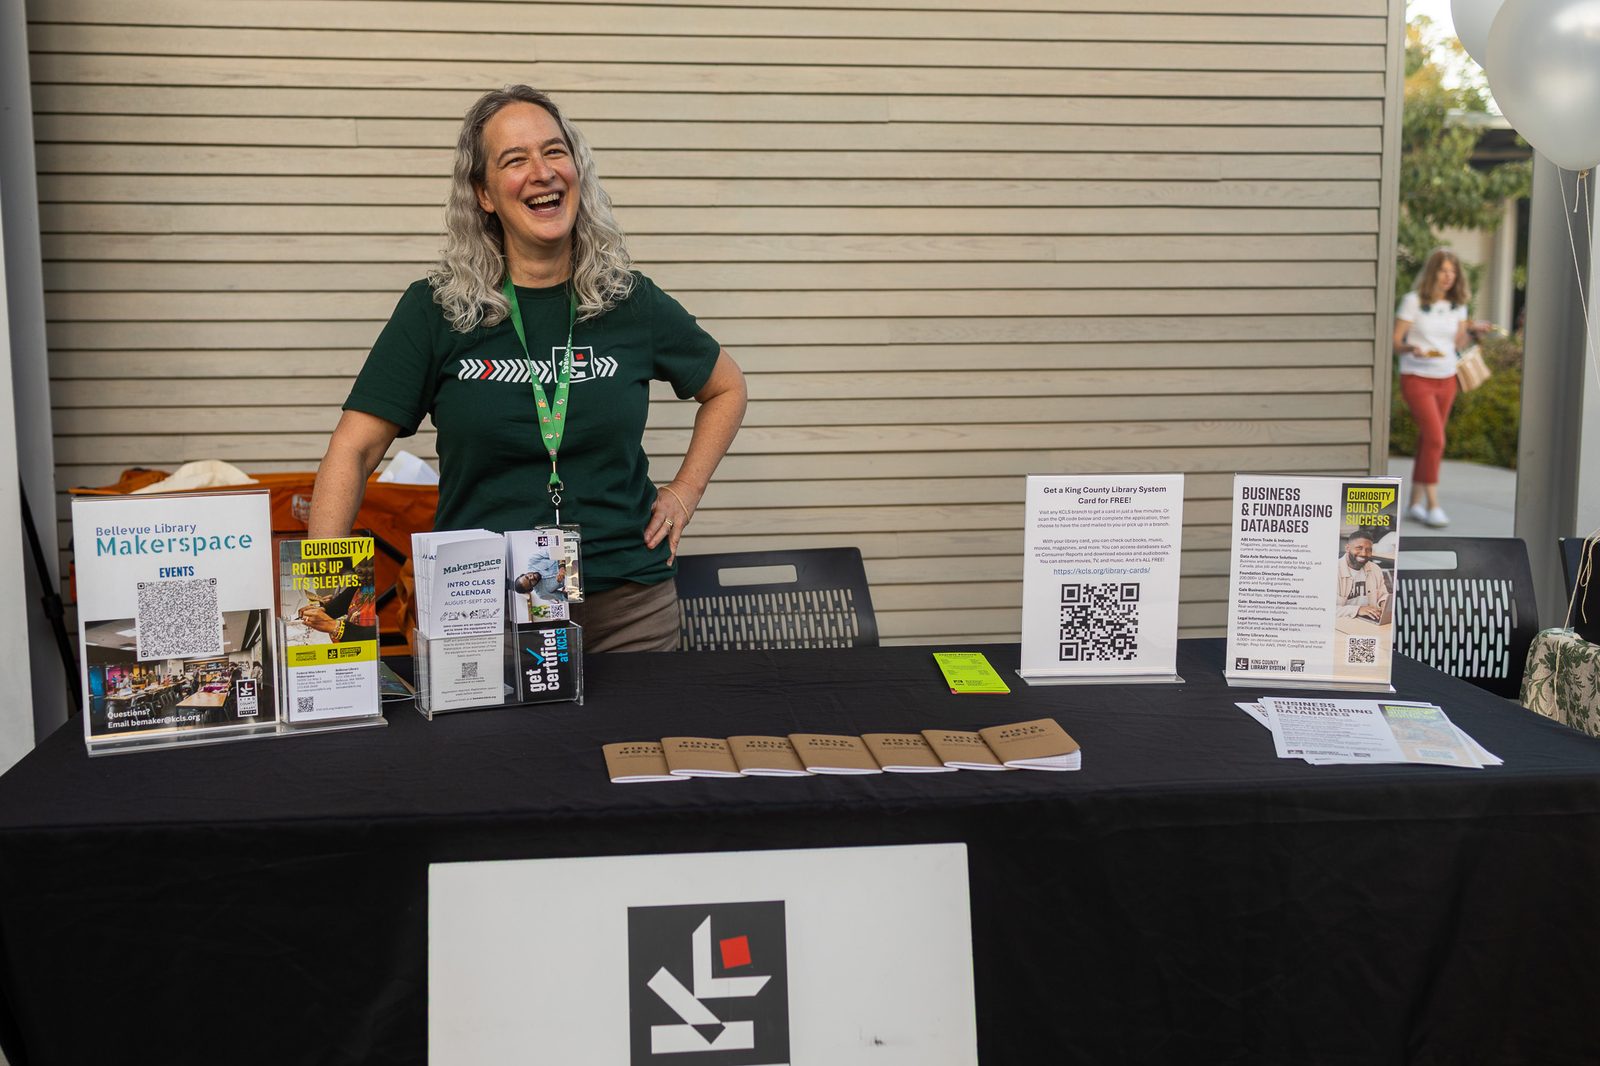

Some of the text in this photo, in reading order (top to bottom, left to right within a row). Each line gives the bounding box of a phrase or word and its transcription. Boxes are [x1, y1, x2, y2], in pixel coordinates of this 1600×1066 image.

[1065, 487, 1081, 495] King
[1083, 487, 1110, 495] County
[1111, 486, 1137, 494] Library
[1139, 486, 1166, 494] System
[1242, 486, 1300, 500] BUSINESS
[1349, 491, 1391, 500] CURIOSITY
[1241, 503, 1333, 518] & FUNDRAISING
[1346, 503, 1379, 513] BUILDS
[1241, 518, 1309, 533] DATABASES
[1346, 514, 1390, 526] SUCCESS
[96, 523, 197, 536] Bellevue Library
[96, 532, 252, 556] Makerspace
[304, 540, 364, 556] CURIOSITY
[159, 566, 194, 578] EVENTS
[292, 560, 344, 575] ROLLS UP
[443, 558, 502, 575] Makerspace
[292, 574, 362, 590] ITS SLEEVES.
[450, 589, 491, 597] CALENDAR
[556, 628, 568, 663] at KCLS
[526, 630, 560, 692] get certified
[108, 709, 151, 719] Questions?
[1276, 709, 1350, 717] DATABASES
[1287, 706, 1373, 715] FUNDRAISING
[108, 713, 200, 729] Email bemaker@kcls.org
[1000, 729, 1045, 738] NOTES
